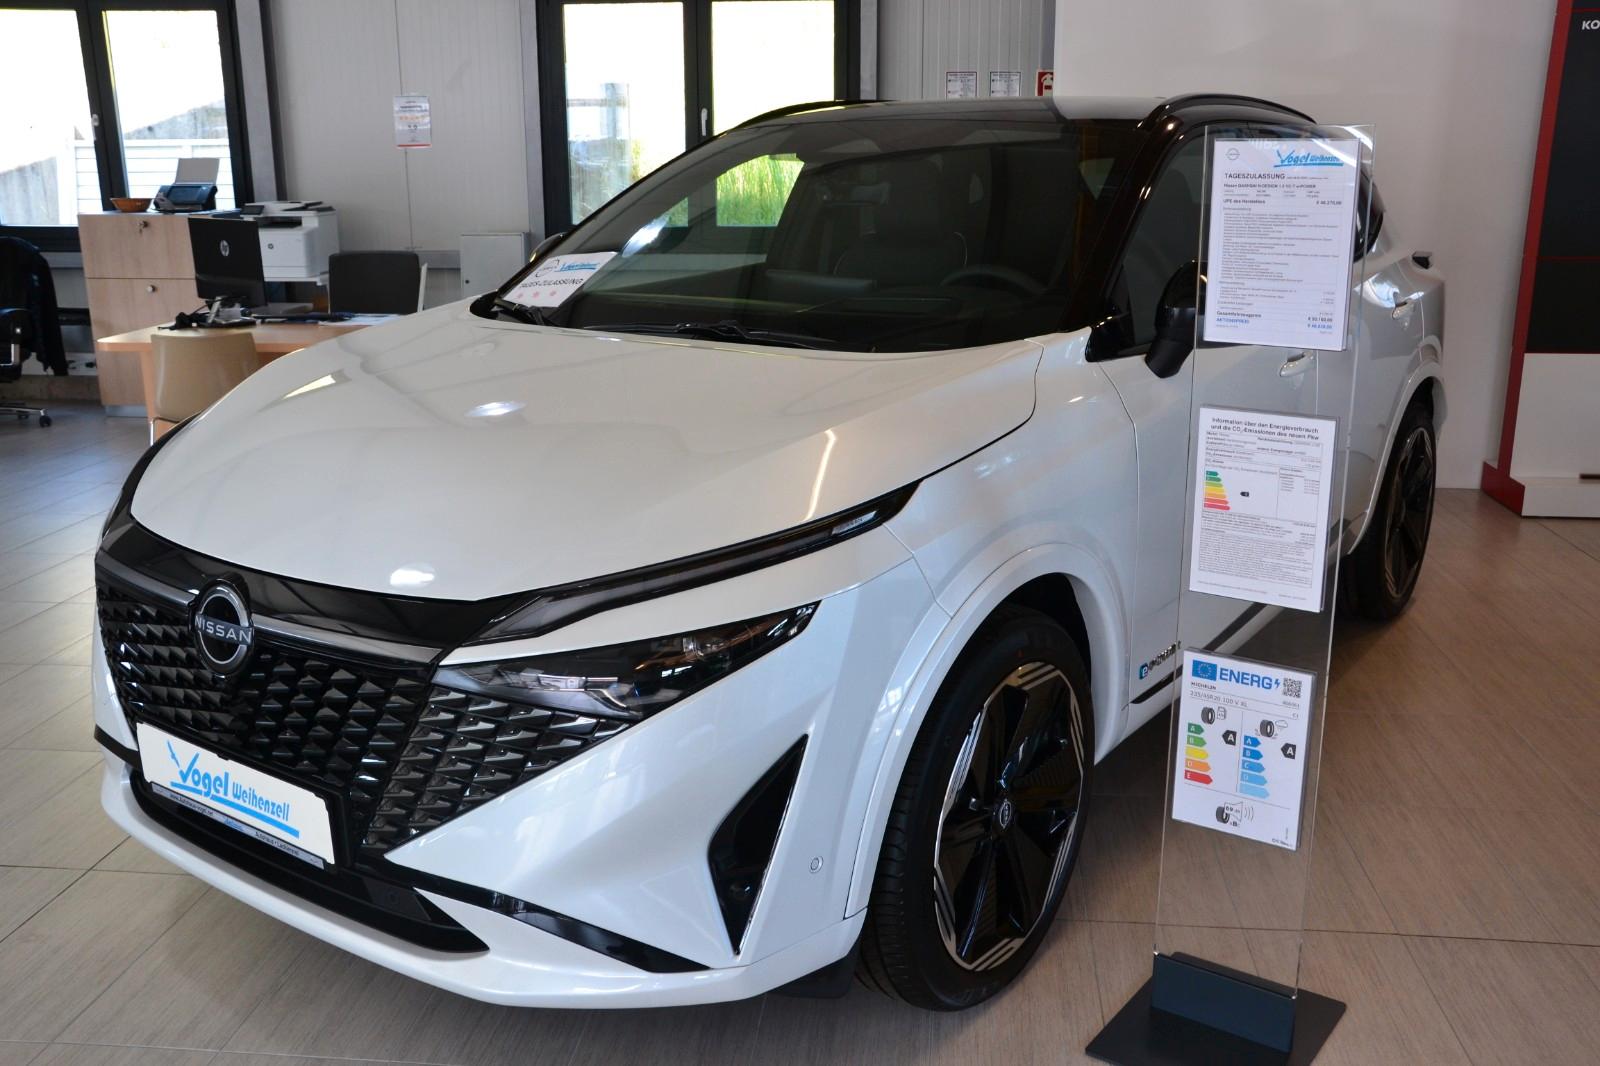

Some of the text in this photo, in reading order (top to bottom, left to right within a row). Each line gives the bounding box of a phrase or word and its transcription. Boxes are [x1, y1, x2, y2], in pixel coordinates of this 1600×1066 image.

[1277, 150, 1310, 164] Vogel
[1224, 172, 1285, 180] TAGESZULASSUNG
[1212, 418, 1243, 426] Information
[1269, 423, 1319, 434] Energieverbrauch
[195, 615, 252, 645] NISSAN
[1220, 667, 1272, 690] ENERG
[1190, 682, 1217, 690] MICHELIN
[1227, 734, 1234, 742] A
[1286, 746, 1294, 755] A
[167, 740, 290, 822] Vogel Weihenzell
